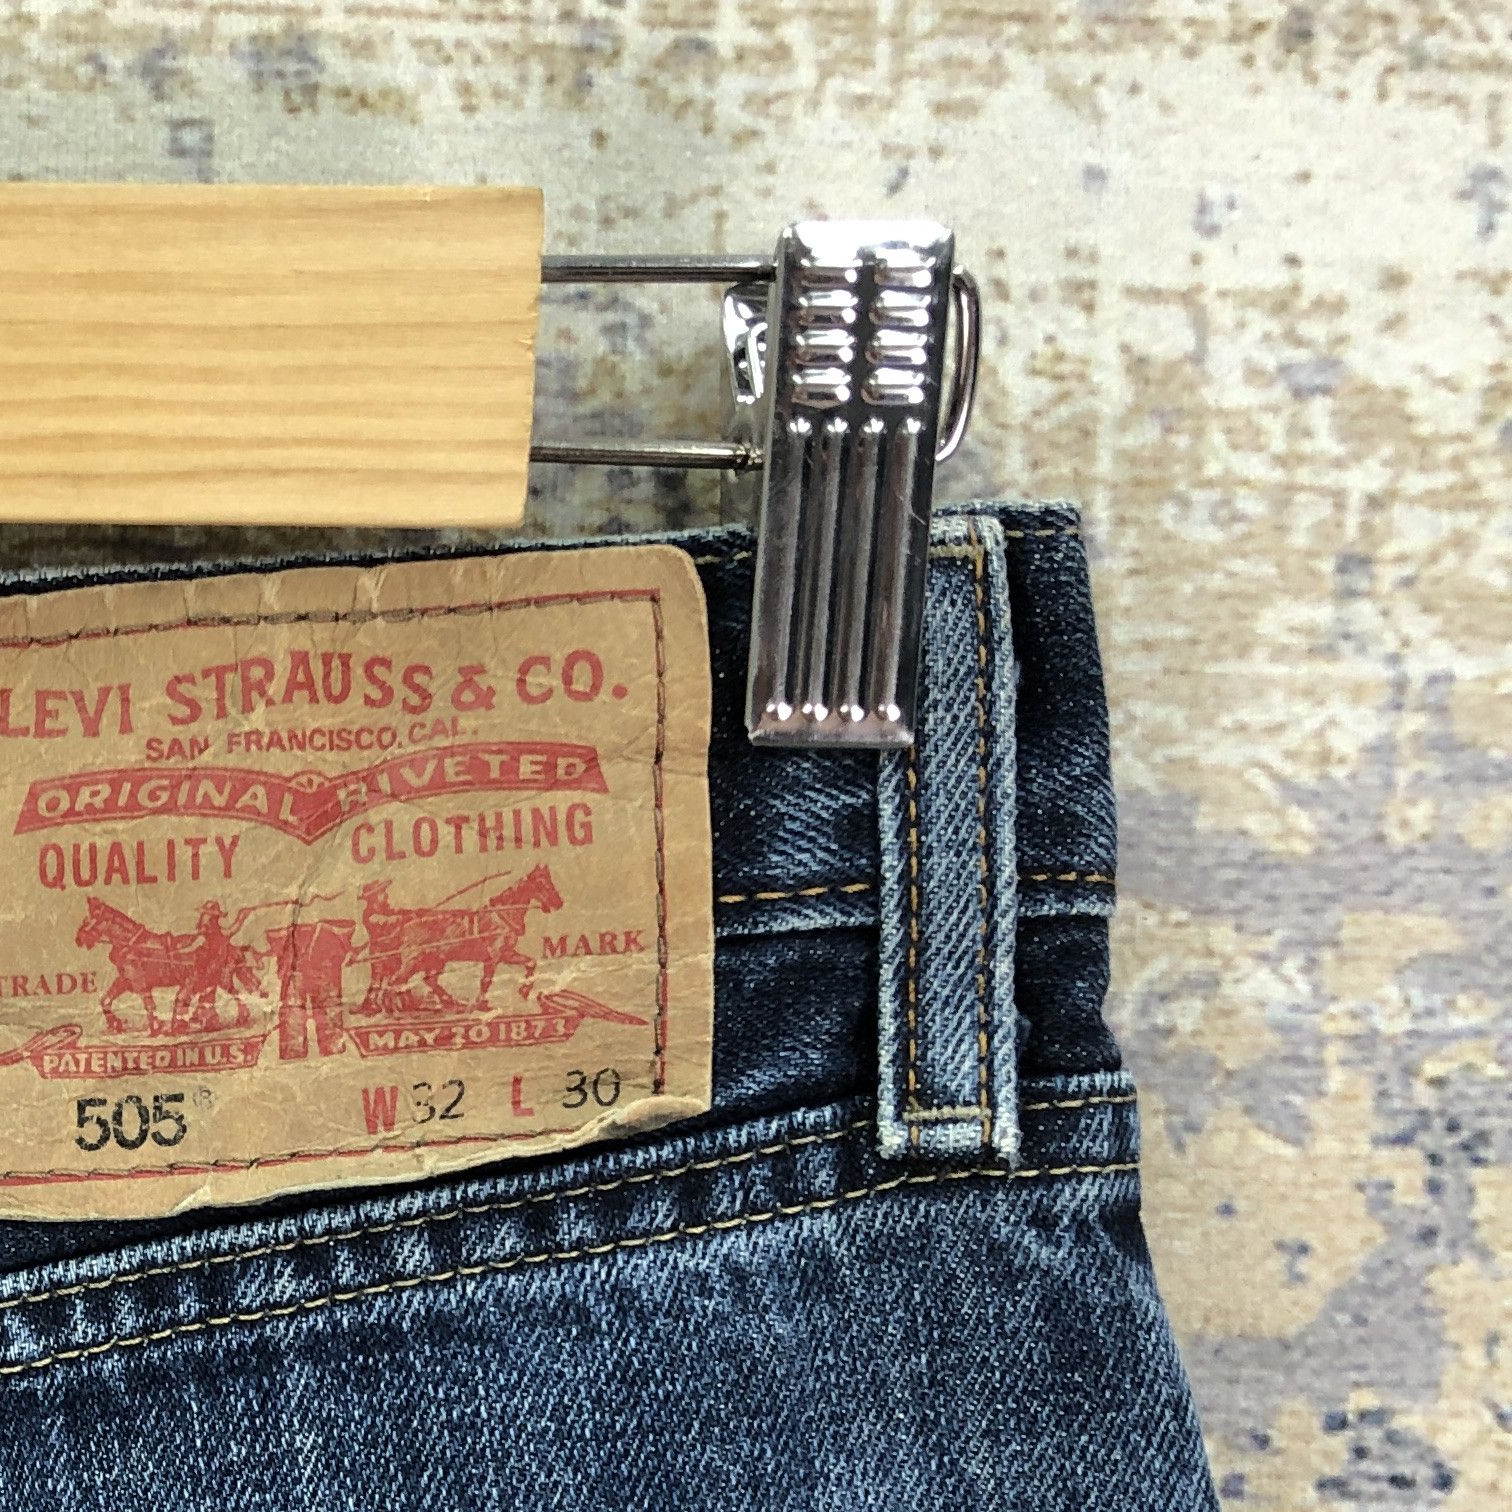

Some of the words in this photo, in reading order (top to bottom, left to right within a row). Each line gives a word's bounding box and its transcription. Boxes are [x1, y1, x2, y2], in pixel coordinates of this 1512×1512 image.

[165, 648, 434, 727] STRAUSS
[449, 662, 497, 713] &
[515, 648, 629, 706] CO.
[144, 735, 211, 763] SAN
[36, 778, 299, 823] ORIGINAL
[337, 752, 589, 813] RIVETED
[38, 834, 240, 891] QUALITY
[350, 802, 595, 864] CLOTHING
[540, 930, 648, 959] MARK
[42, 1052, 170, 1074] PATENTED
[175, 1048, 203, 1067] IN
[367, 1027, 441, 1052] MAY
[361, 1085, 400, 1136] W
[412, 1079, 466, 1124] 32
[511, 1073, 536, 1118] L
[562, 1067, 622, 1109] 30
